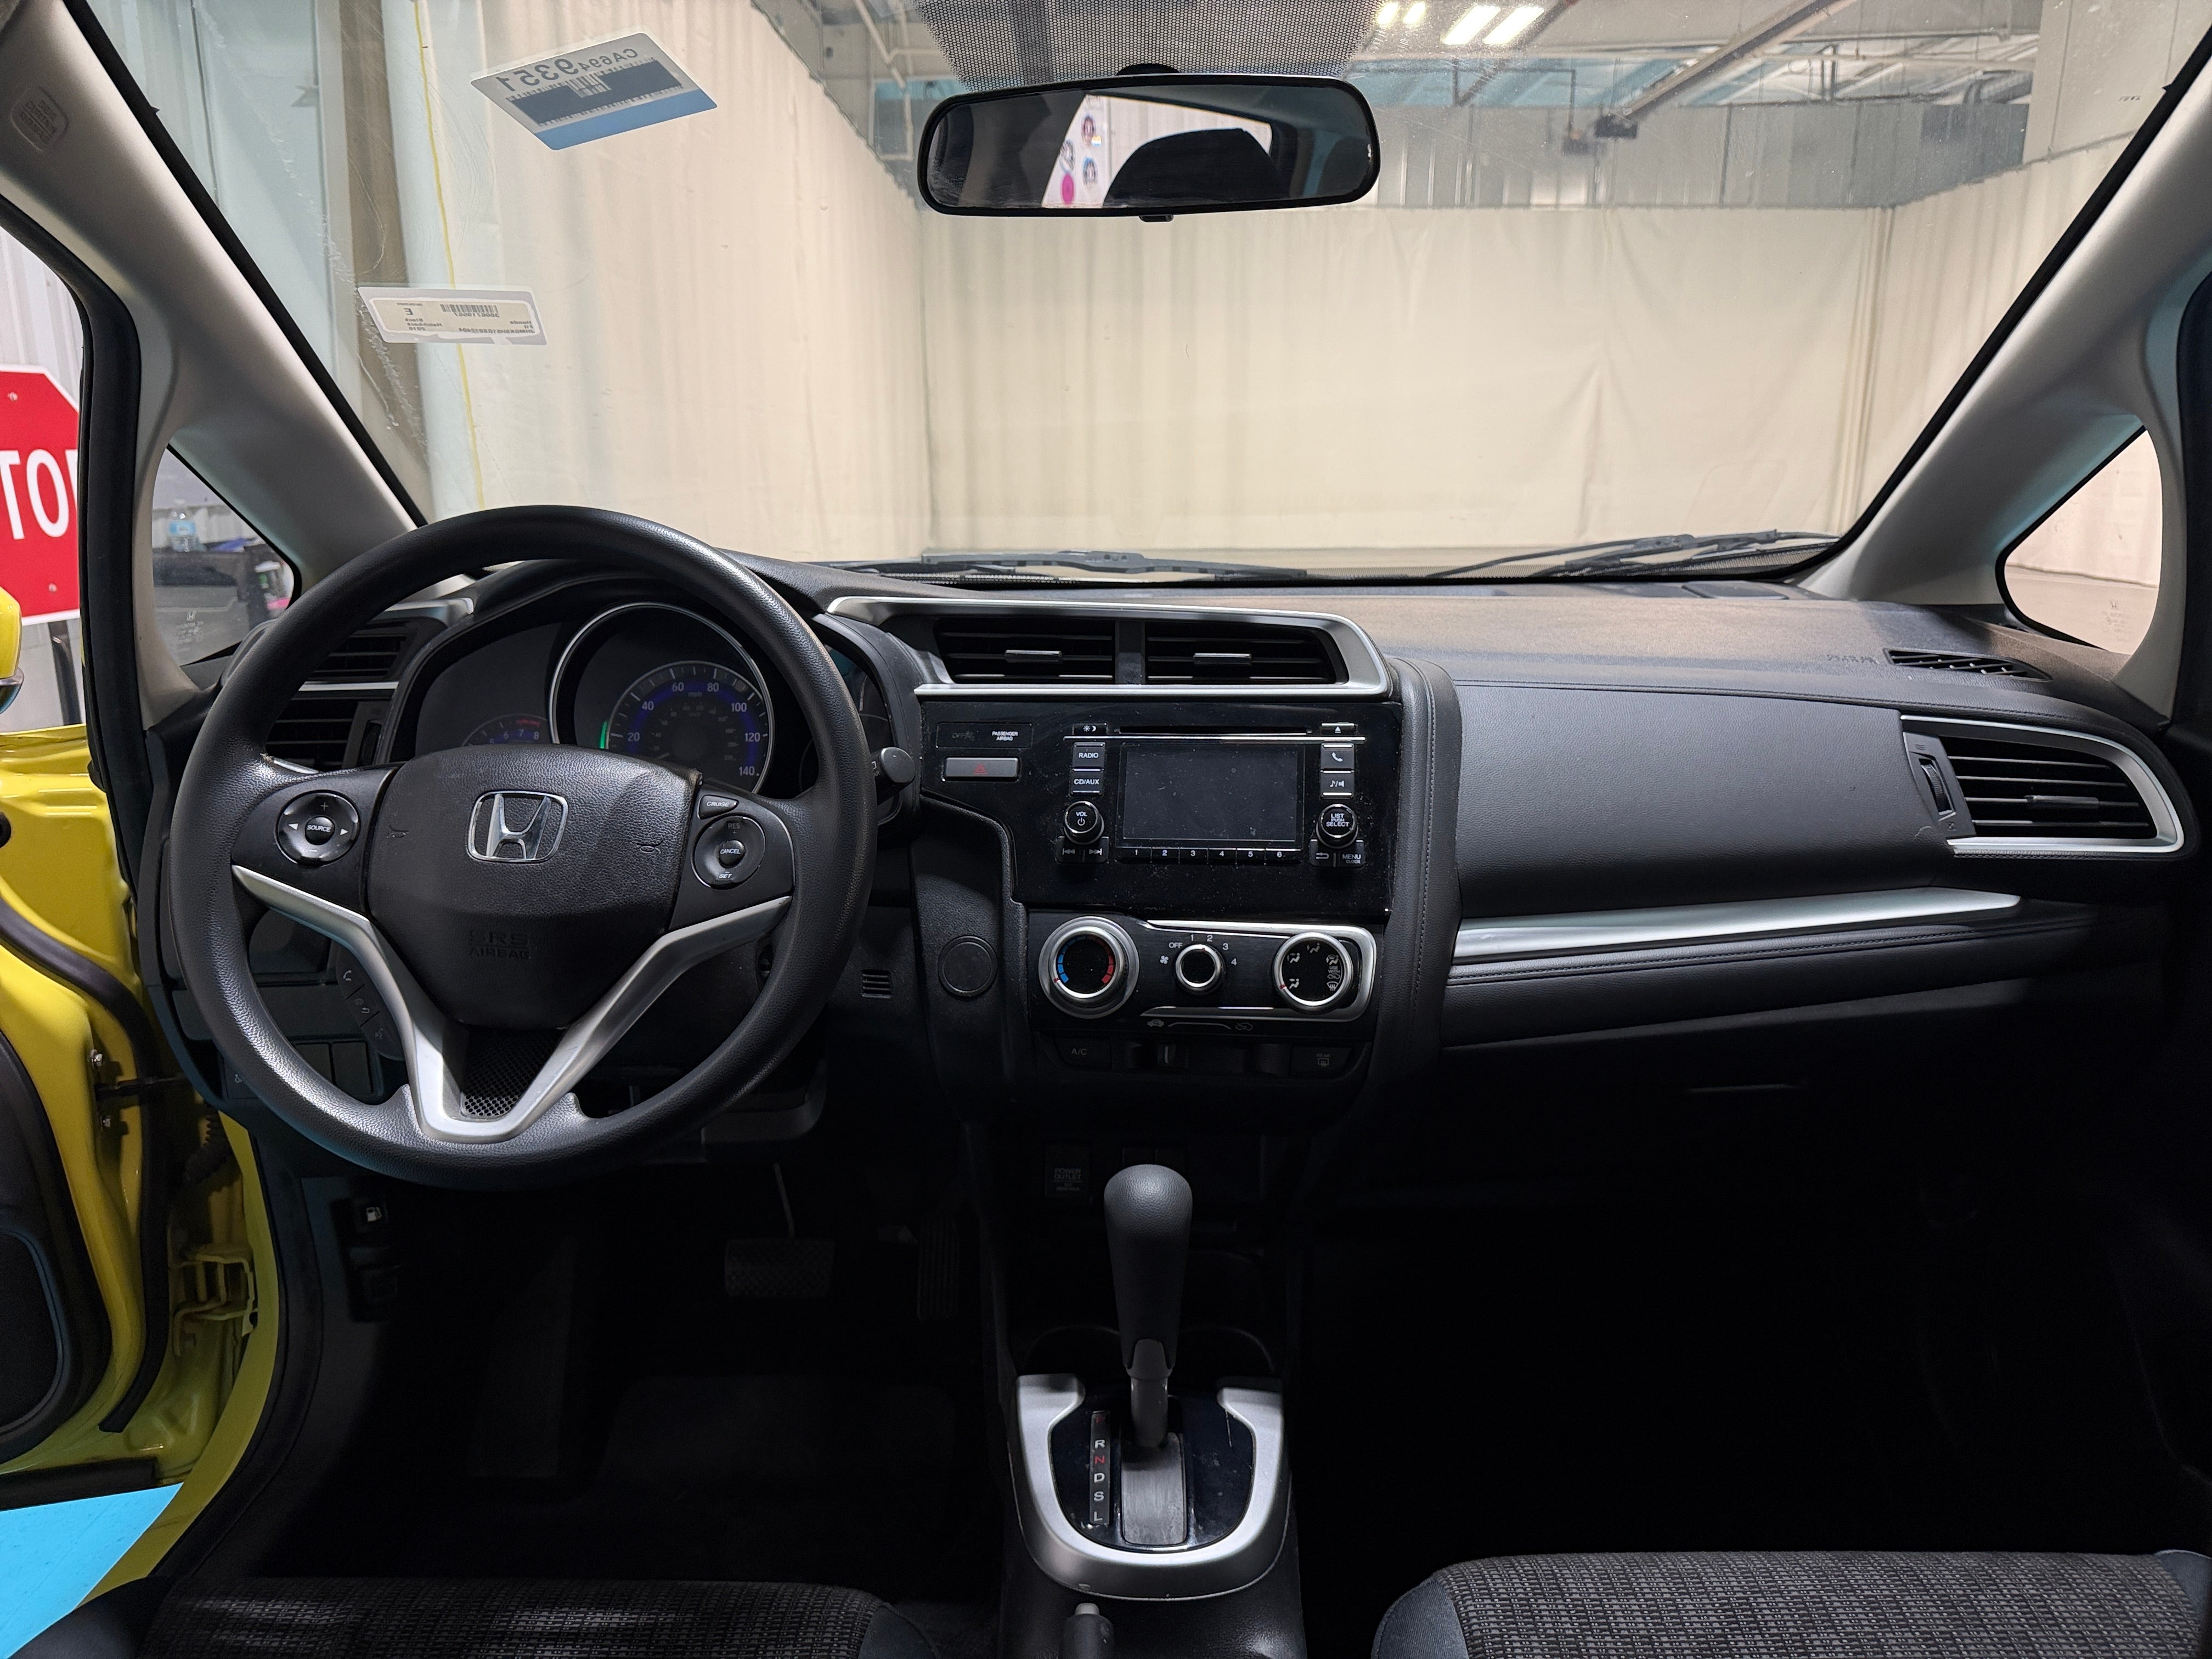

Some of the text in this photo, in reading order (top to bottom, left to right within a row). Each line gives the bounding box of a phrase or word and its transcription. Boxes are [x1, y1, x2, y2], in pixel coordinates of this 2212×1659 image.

[672, 681, 684, 693] 60
[707, 681, 719, 693] 80
[642, 701, 654, 711] 40
[731, 702, 747, 713] 100
[503, 731, 510, 740] 6
[517, 729, 524, 737] 7
[533, 731, 540, 741] 8
[628, 732, 640, 742] 20
[744, 732, 761, 743] 120
[738, 765, 755, 777] 140
[307, 824, 331, 833] SOURCE
[469, 947, 531, 960] AIRBAG
[1094, 1440, 1105, 1448] R
[1094, 1455, 1105, 1464] N
[1094, 1472, 1105, 1482] D
[1093, 1491, 1104, 1501] S
[1093, 1511, 1103, 1522] L
